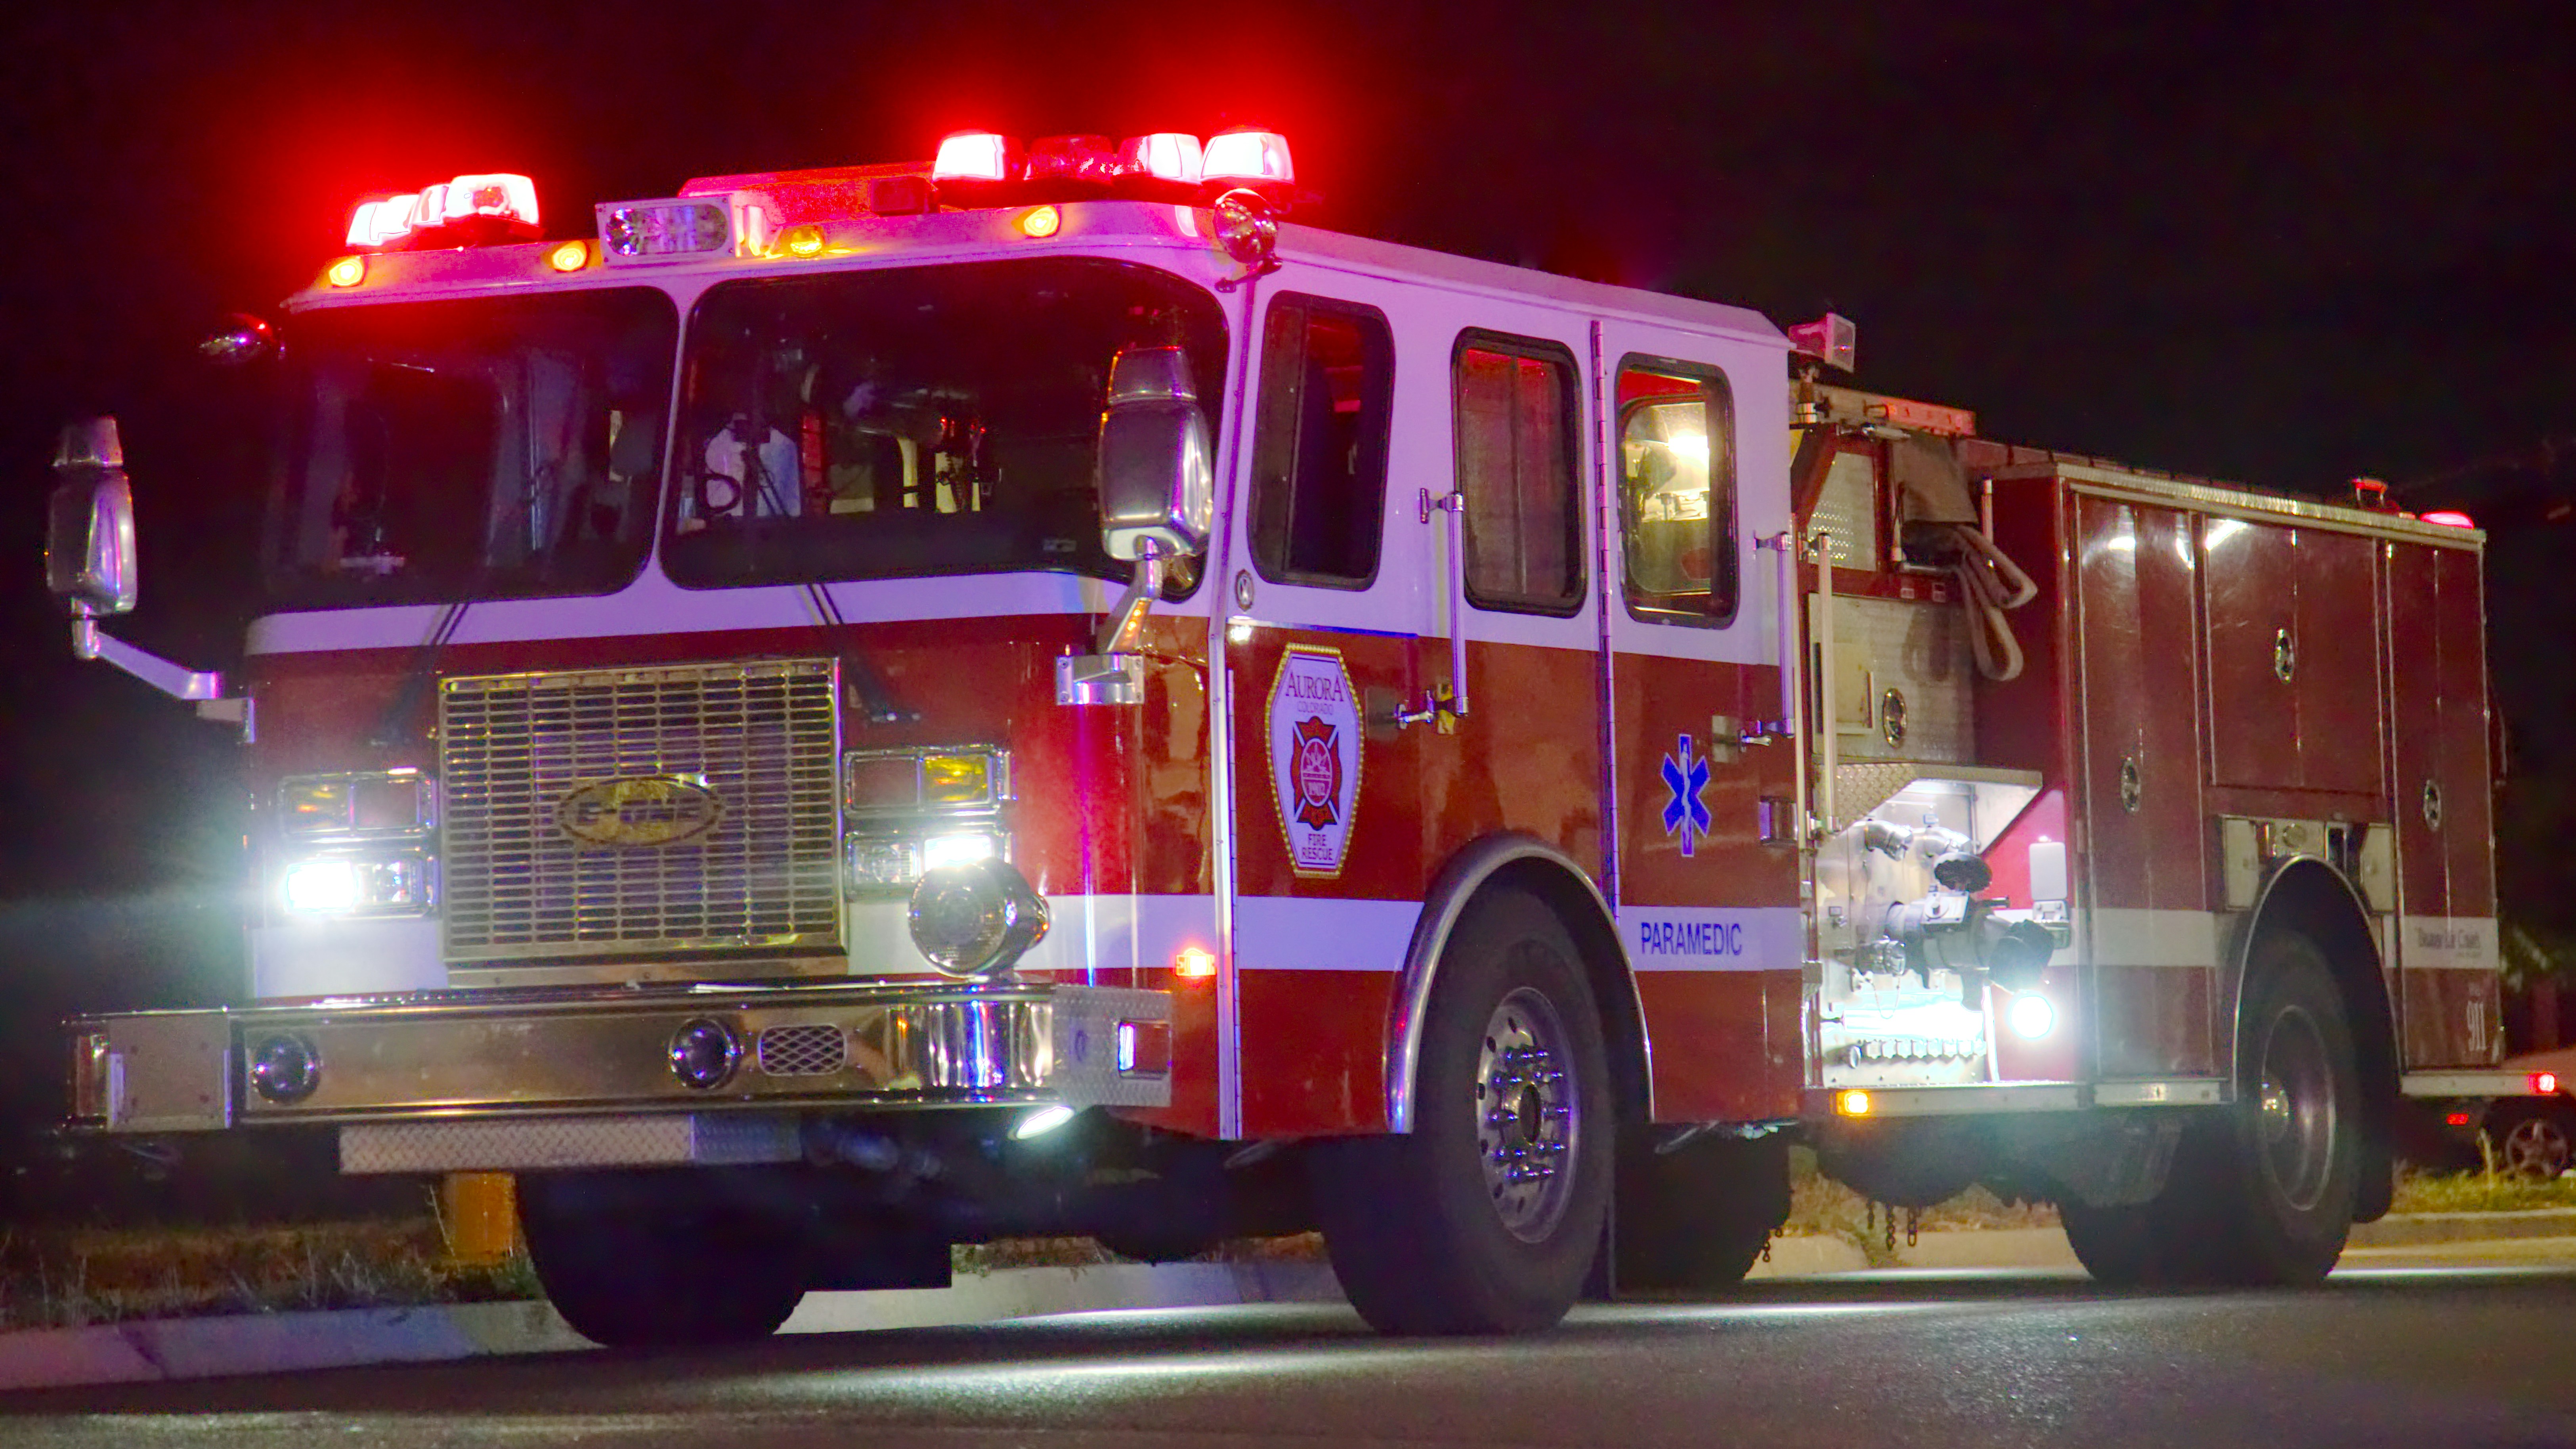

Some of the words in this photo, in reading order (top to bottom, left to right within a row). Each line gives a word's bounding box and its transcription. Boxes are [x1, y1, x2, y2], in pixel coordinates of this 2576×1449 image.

[1285, 672, 1344, 702] AURORA
[1301, 847, 1333, 860] RESCUE
[1308, 833, 1326, 846] FIRE
[1641, 922, 1742, 955] PARAMEDIC
[2467, 1000, 2487, 1051] 911
